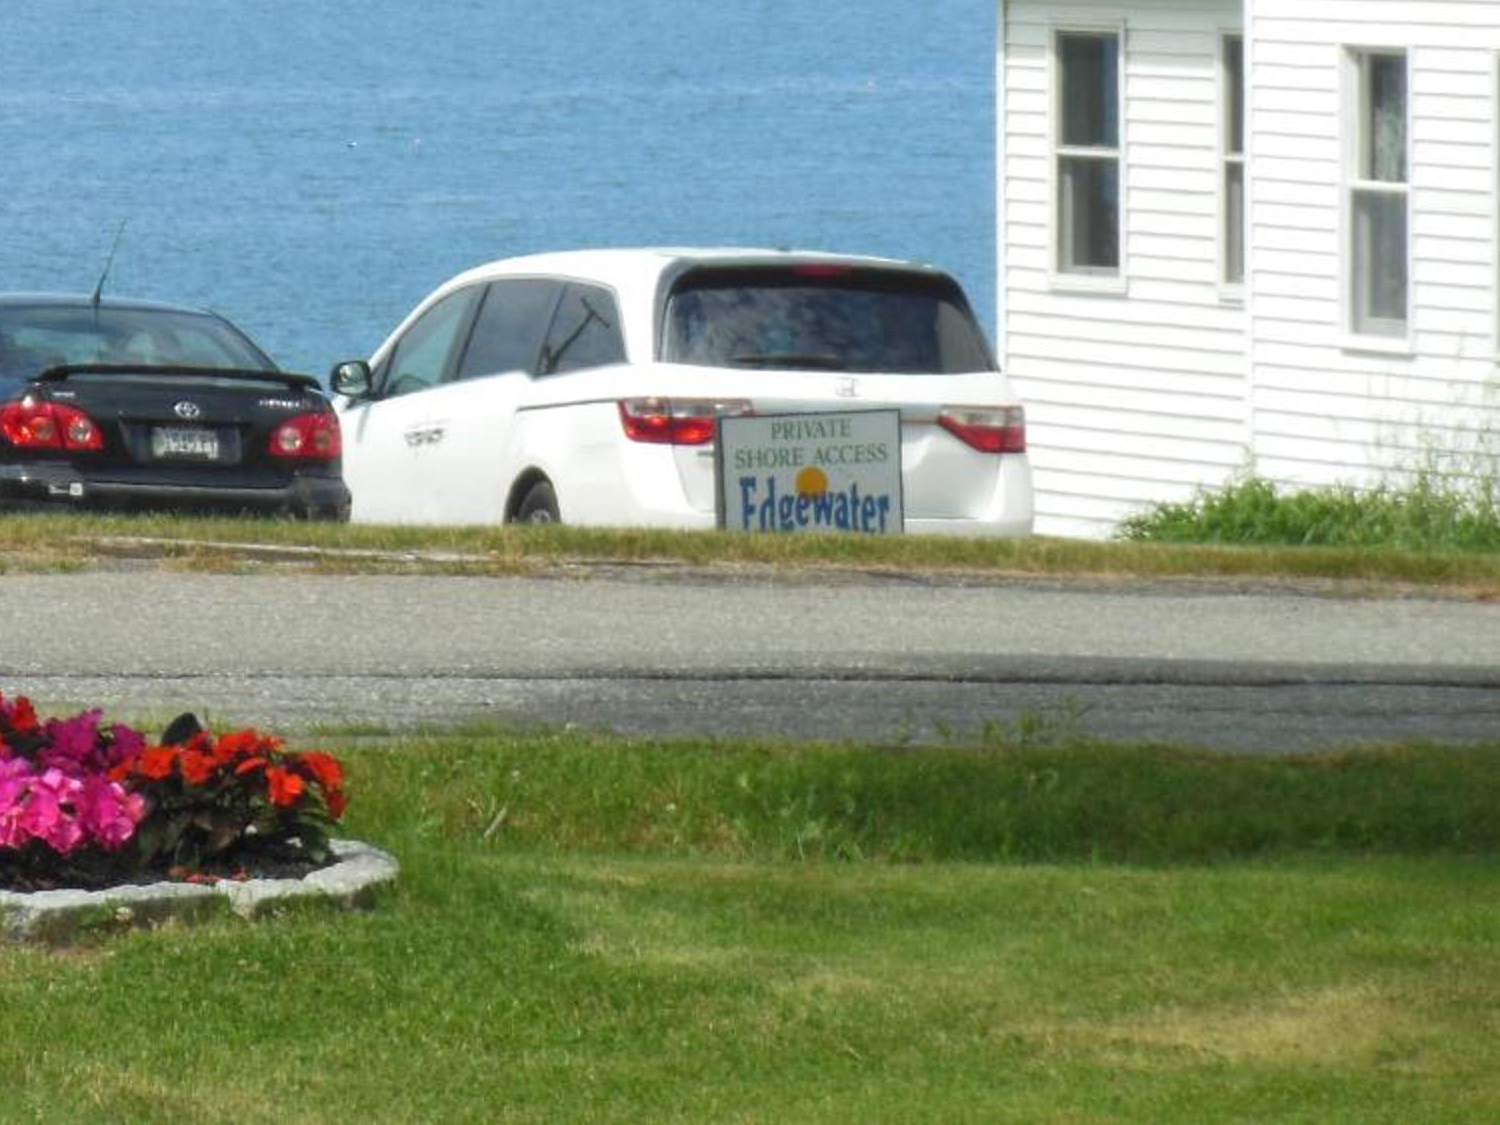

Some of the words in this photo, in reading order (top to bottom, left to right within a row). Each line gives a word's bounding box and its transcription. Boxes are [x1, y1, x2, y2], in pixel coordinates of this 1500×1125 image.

[771, 418, 853, 440] PRIVATE
[734, 448, 805, 469] SHORE
[815, 443, 889, 465] ACCESS
[739, 475, 890, 533] Edgewater
